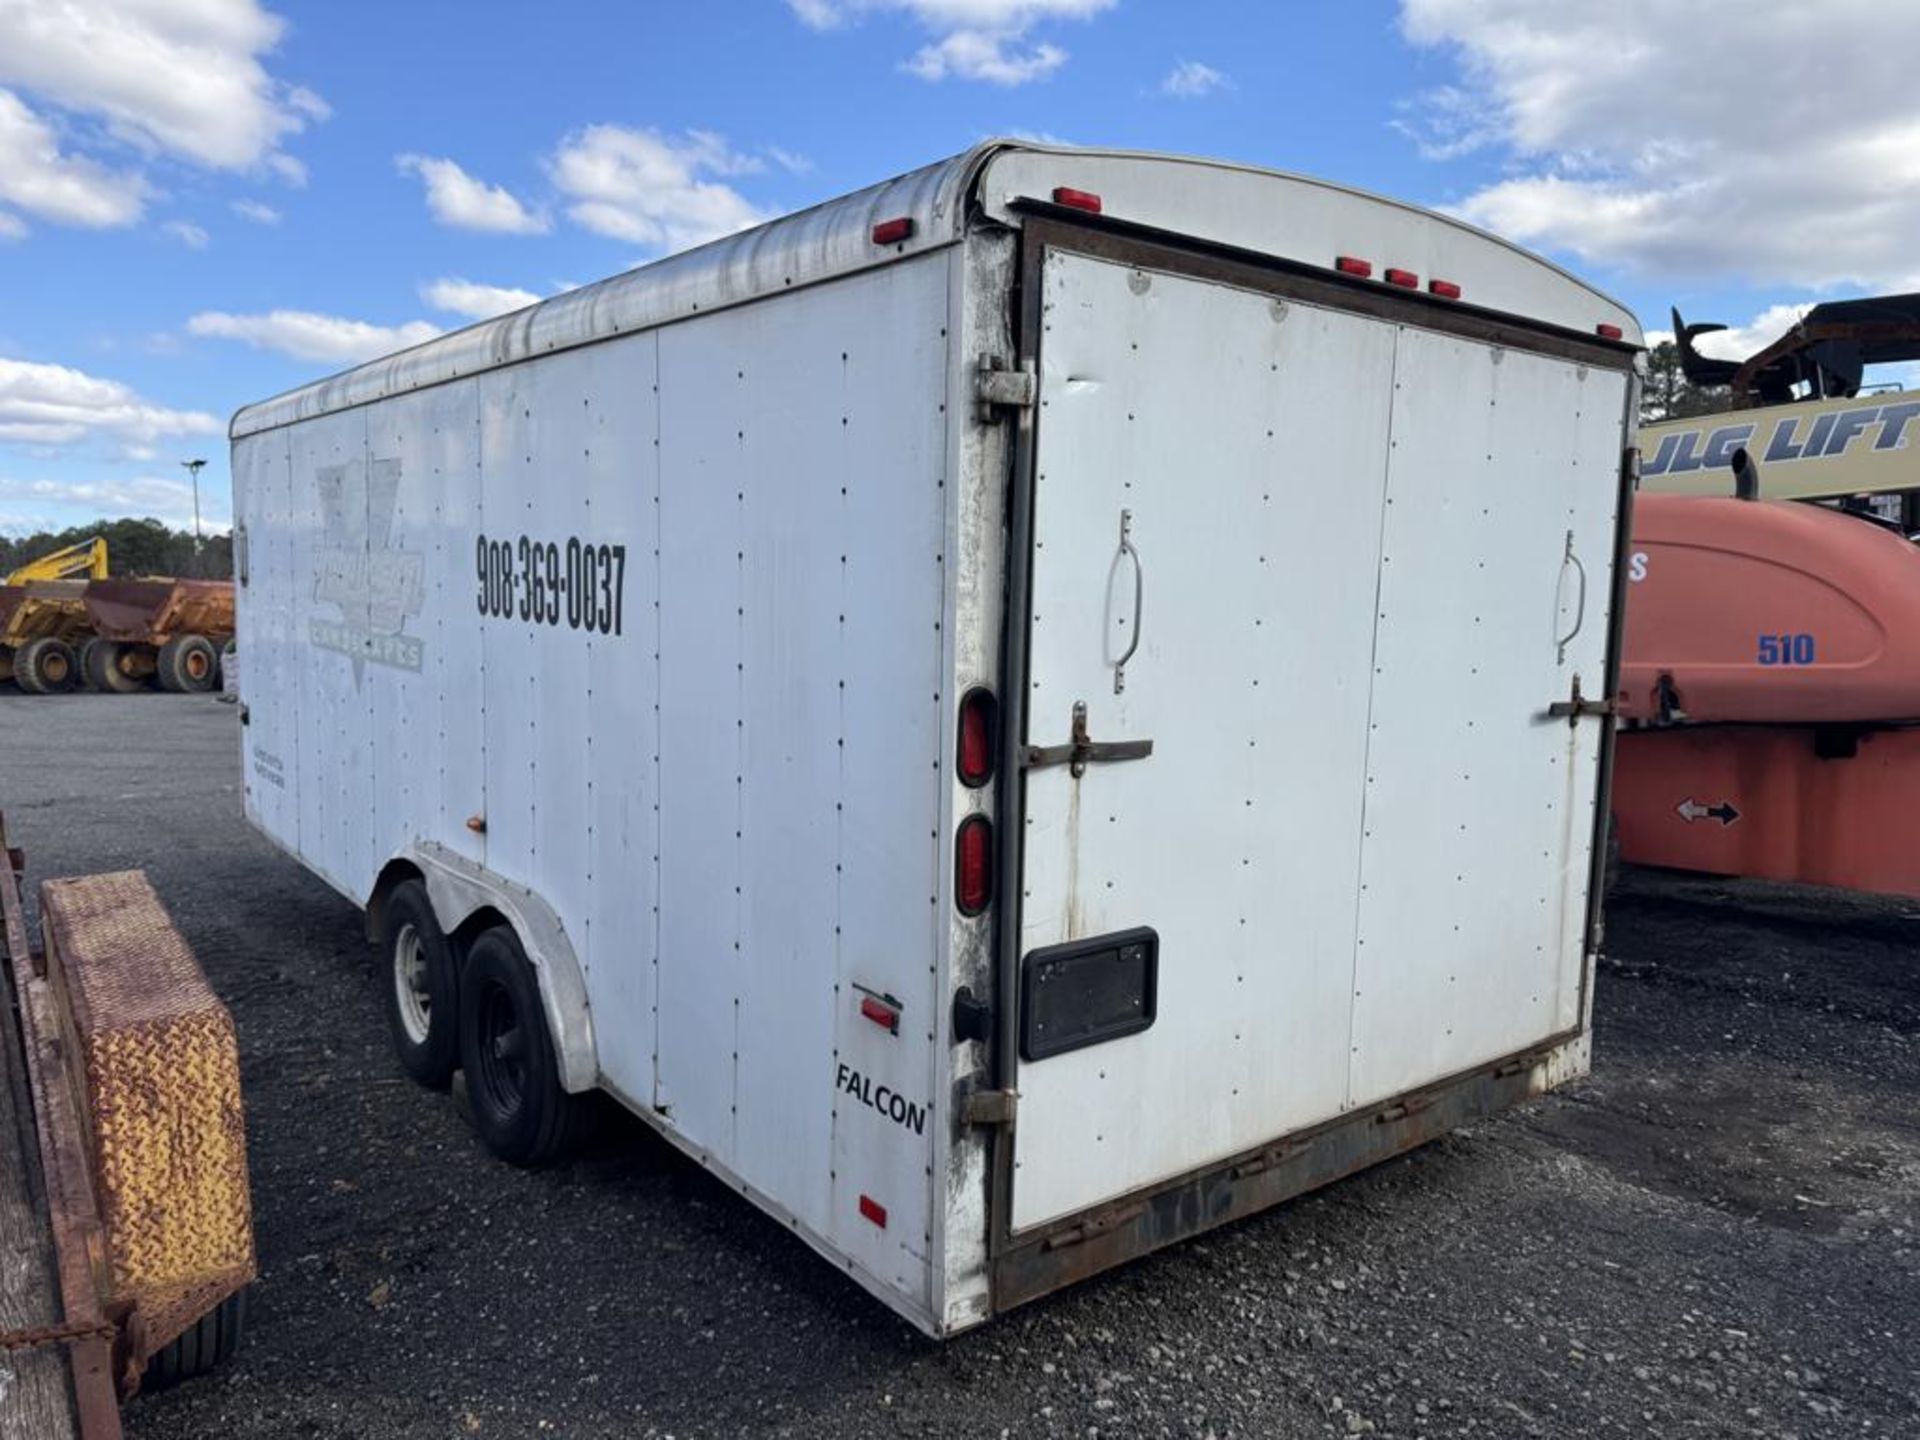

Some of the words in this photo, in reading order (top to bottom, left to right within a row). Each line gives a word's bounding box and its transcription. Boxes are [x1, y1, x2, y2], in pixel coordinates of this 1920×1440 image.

[1640, 423, 1757, 477] JLG
[1764, 401, 1920, 463] LIFT
[477, 534, 625, 636] 908-369-0037
[1758, 634, 1814, 665] 510
[836, 1063, 926, 1135] FALCON
